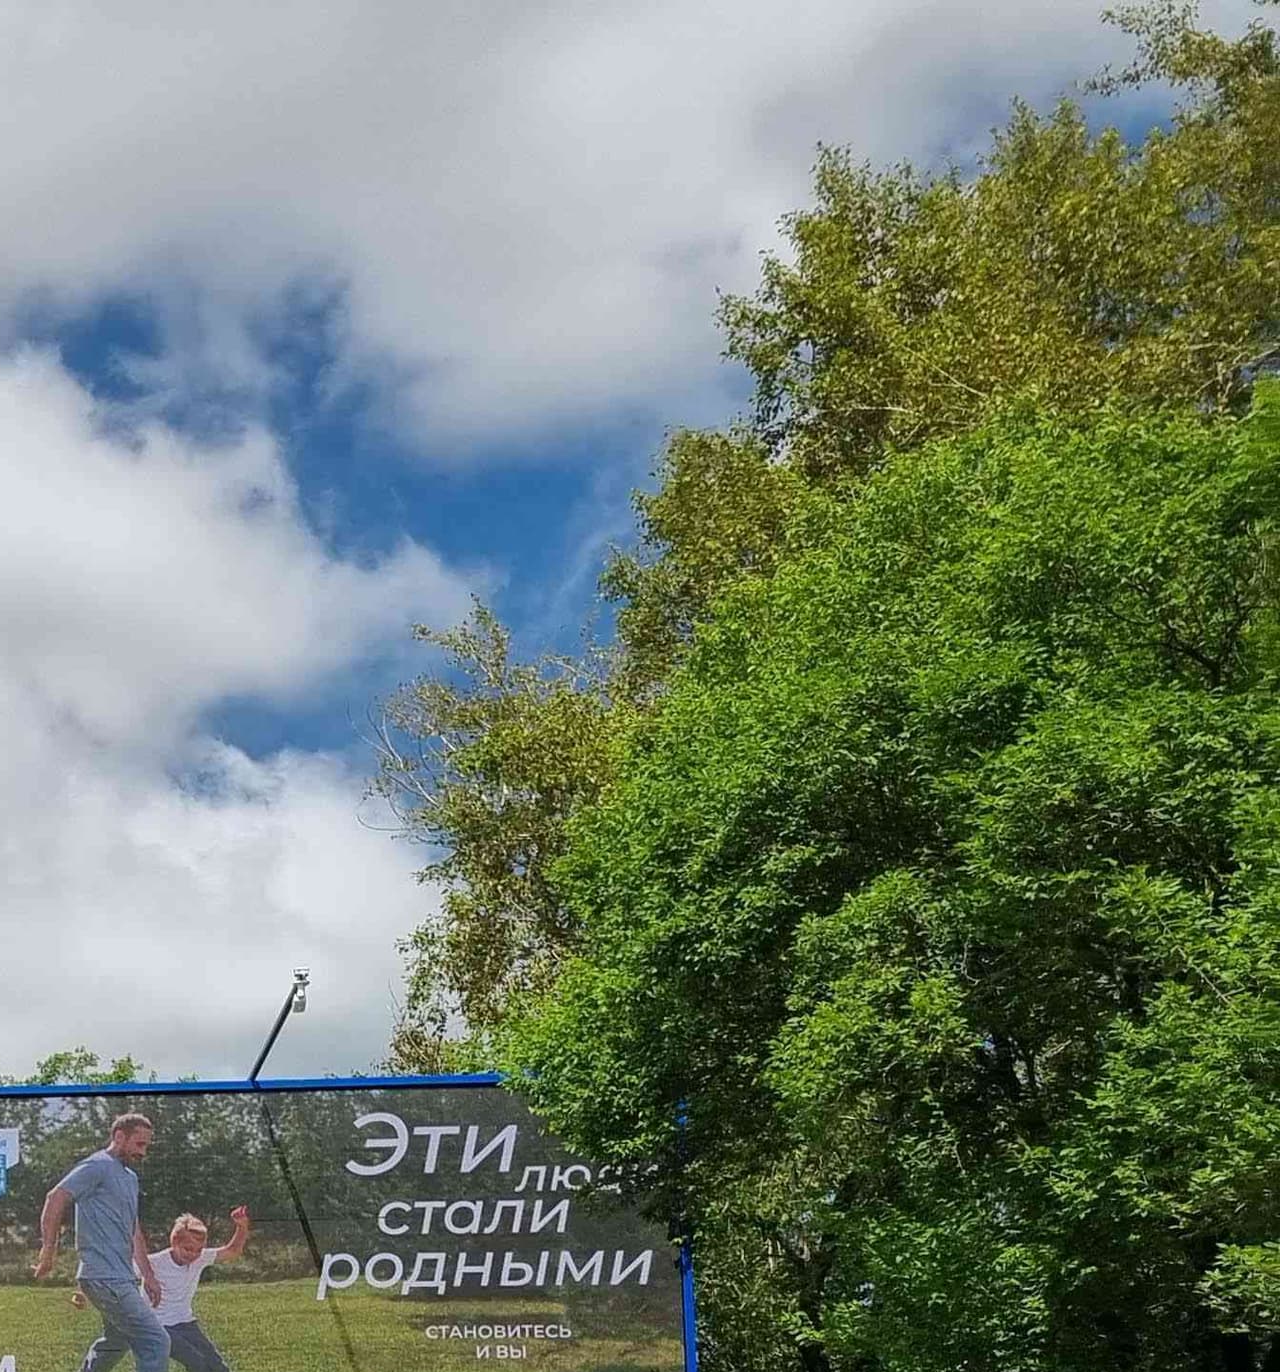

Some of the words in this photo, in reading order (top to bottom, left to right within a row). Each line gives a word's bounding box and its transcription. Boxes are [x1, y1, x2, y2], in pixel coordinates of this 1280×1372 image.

[345, 1111, 518, 1176] Эти
[377, 1199, 570, 1236] стали
[315, 1249, 654, 1300] родными
[425, 1324, 572, 1339] СТАНОВИТЕСЬ
[476, 1346, 490, 1359] И
[496, 1346, 527, 1359] ВЫ
